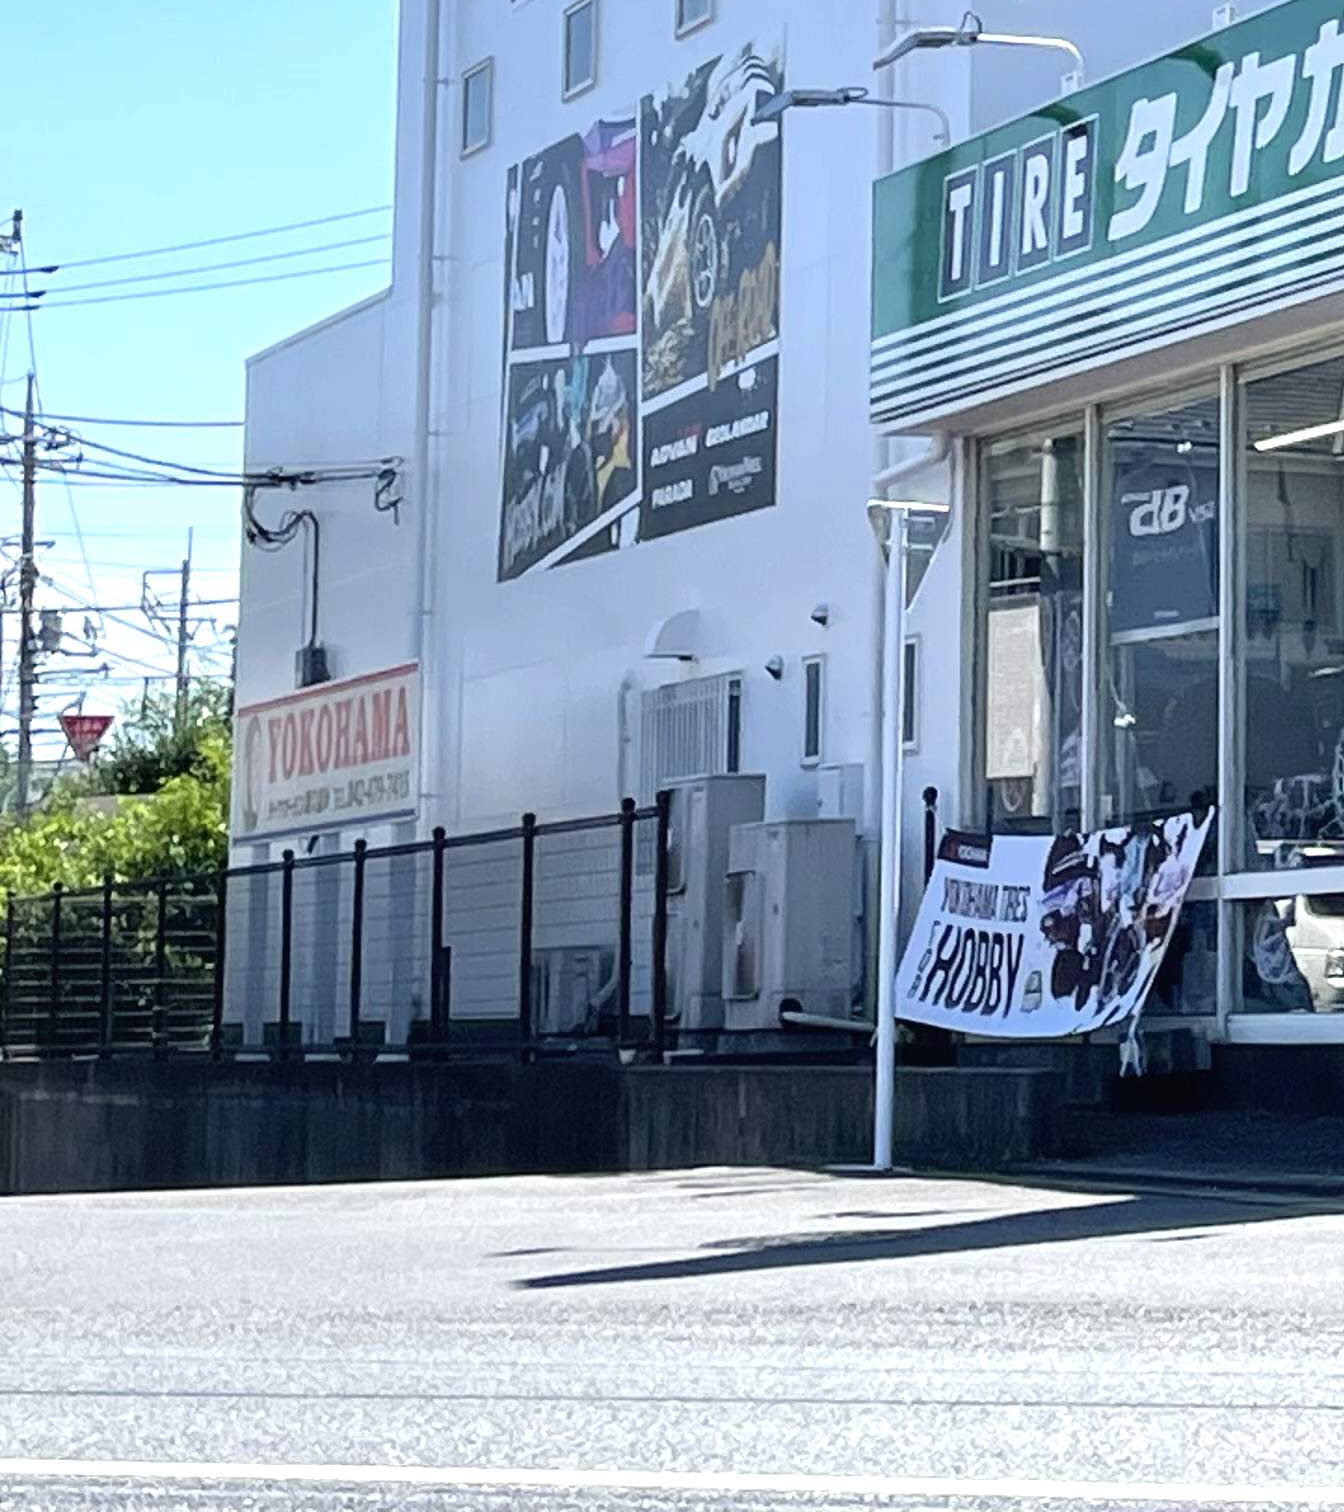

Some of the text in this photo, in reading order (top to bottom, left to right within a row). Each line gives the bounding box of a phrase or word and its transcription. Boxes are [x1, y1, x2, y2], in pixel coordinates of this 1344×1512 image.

[948, 131, 1088, 282] TIRE
[268, 686, 410, 784] YOKOHAMA
[918, 923, 1025, 1019] HOBBY
